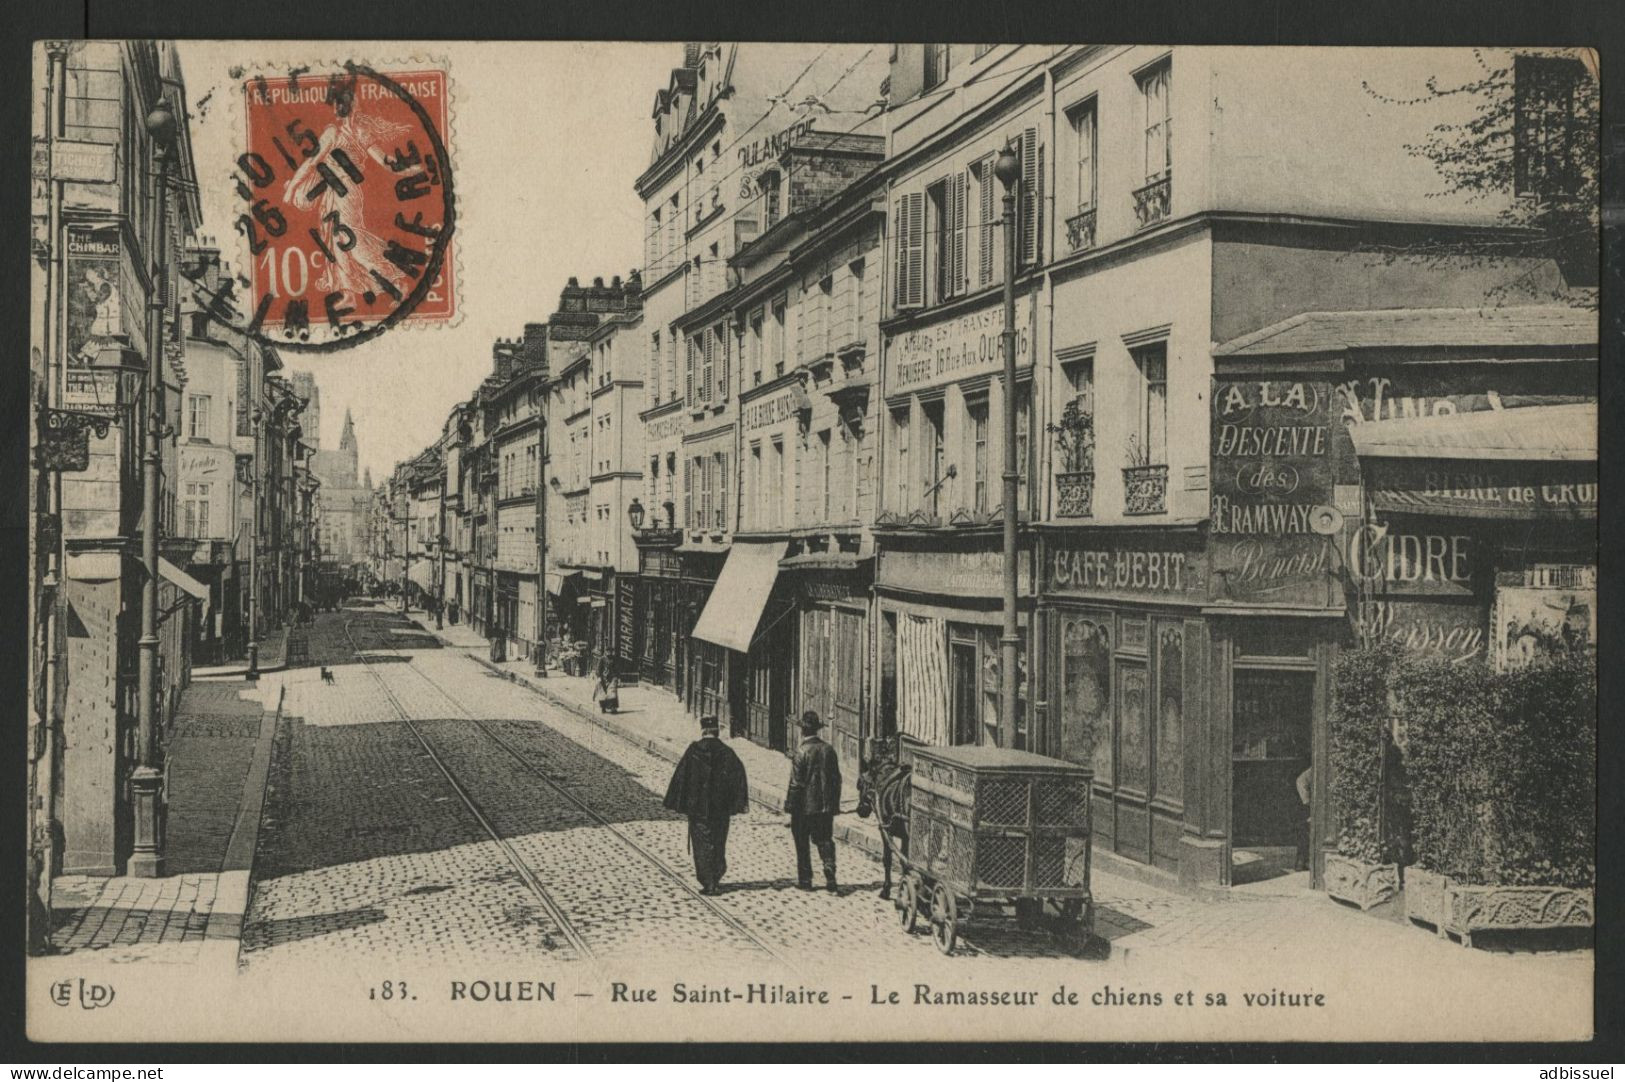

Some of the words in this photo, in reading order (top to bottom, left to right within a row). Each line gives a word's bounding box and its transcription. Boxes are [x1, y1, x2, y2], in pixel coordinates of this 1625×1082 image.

[308, 210, 357, 263] 13
[260, 246, 309, 298] 10
[979, 333, 1006, 363] OUR
[1222, 384, 1251, 416] A
[1258, 381, 1309, 411] LA
[1216, 424, 1327, 457] DESCENTE
[1250, 465, 1288, 488] des
[1053, 550, 1109, 587] CAFE
[1114, 551, 1185, 590] DEBIT
[1350, 520, 1472, 581] CIDRE
[620, 579, 634, 661] PHARMACIE
